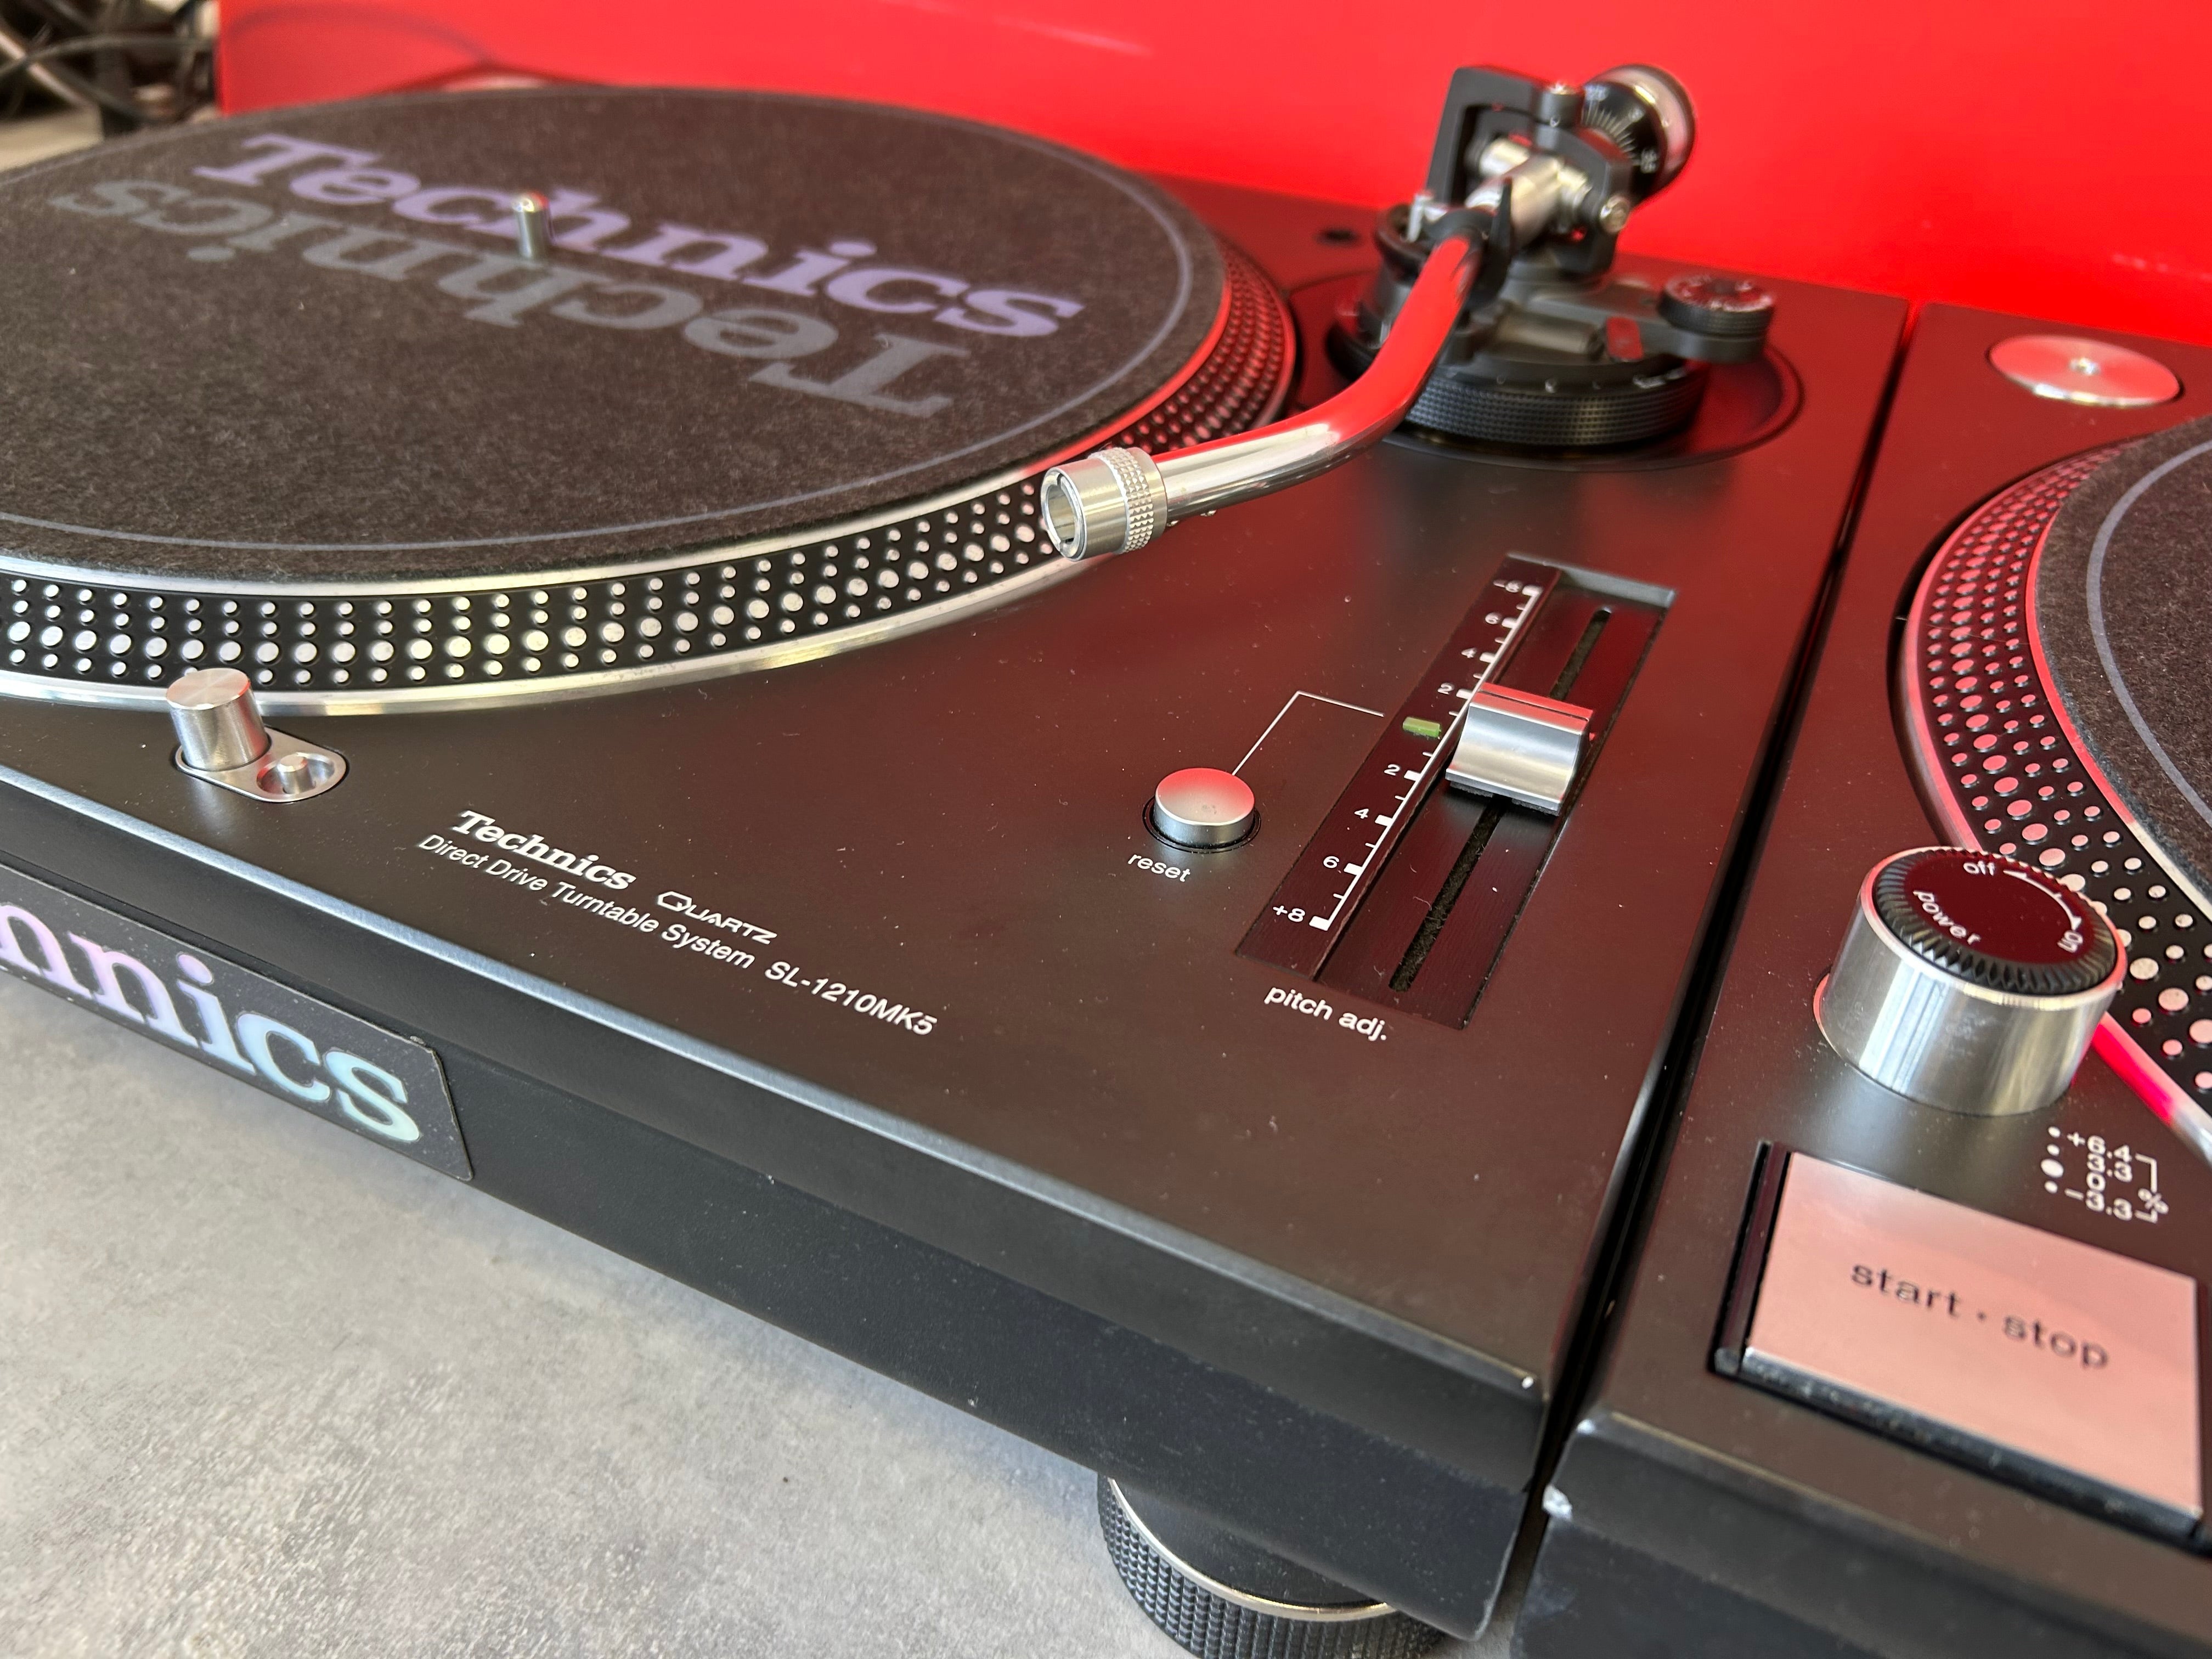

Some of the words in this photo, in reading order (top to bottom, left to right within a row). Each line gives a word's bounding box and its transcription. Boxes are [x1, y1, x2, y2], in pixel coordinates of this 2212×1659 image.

[193, 133, 1086, 338] Technics
[47, 178, 972, 419] Technics
[1485, 612, 1503, 625] 6
[1461, 647, 1477, 658] 4
[1437, 682, 1454, 695] 2
[1384, 764, 1401, 776] 2
[1354, 808, 1370, 819] 4
[452, 810, 637, 890] Technics
[1127, 854, 1191, 882] reset
[1323, 856, 1340, 869] 6
[1962, 860, 1996, 876] off
[656, 890, 778, 945] QUARTZ
[1273, 905, 1306, 923] +8
[1912, 889, 1982, 945] power
[417, 834, 490, 869] Direct
[484, 859, 549, 891] Drive
[551, 881, 660, 933] Turntable
[661, 923, 756, 969] System
[764, 961, 938, 1036] SL-1210MK5
[2057, 930, 2084, 953] on
[1263, 987, 1334, 1021] pitch
[1338, 1012, 1387, 1042] adj.
[2086, 1172, 2107, 1192] 0
[1850, 1263, 1960, 1318] start
[2004, 1315, 2109, 1369] stop
